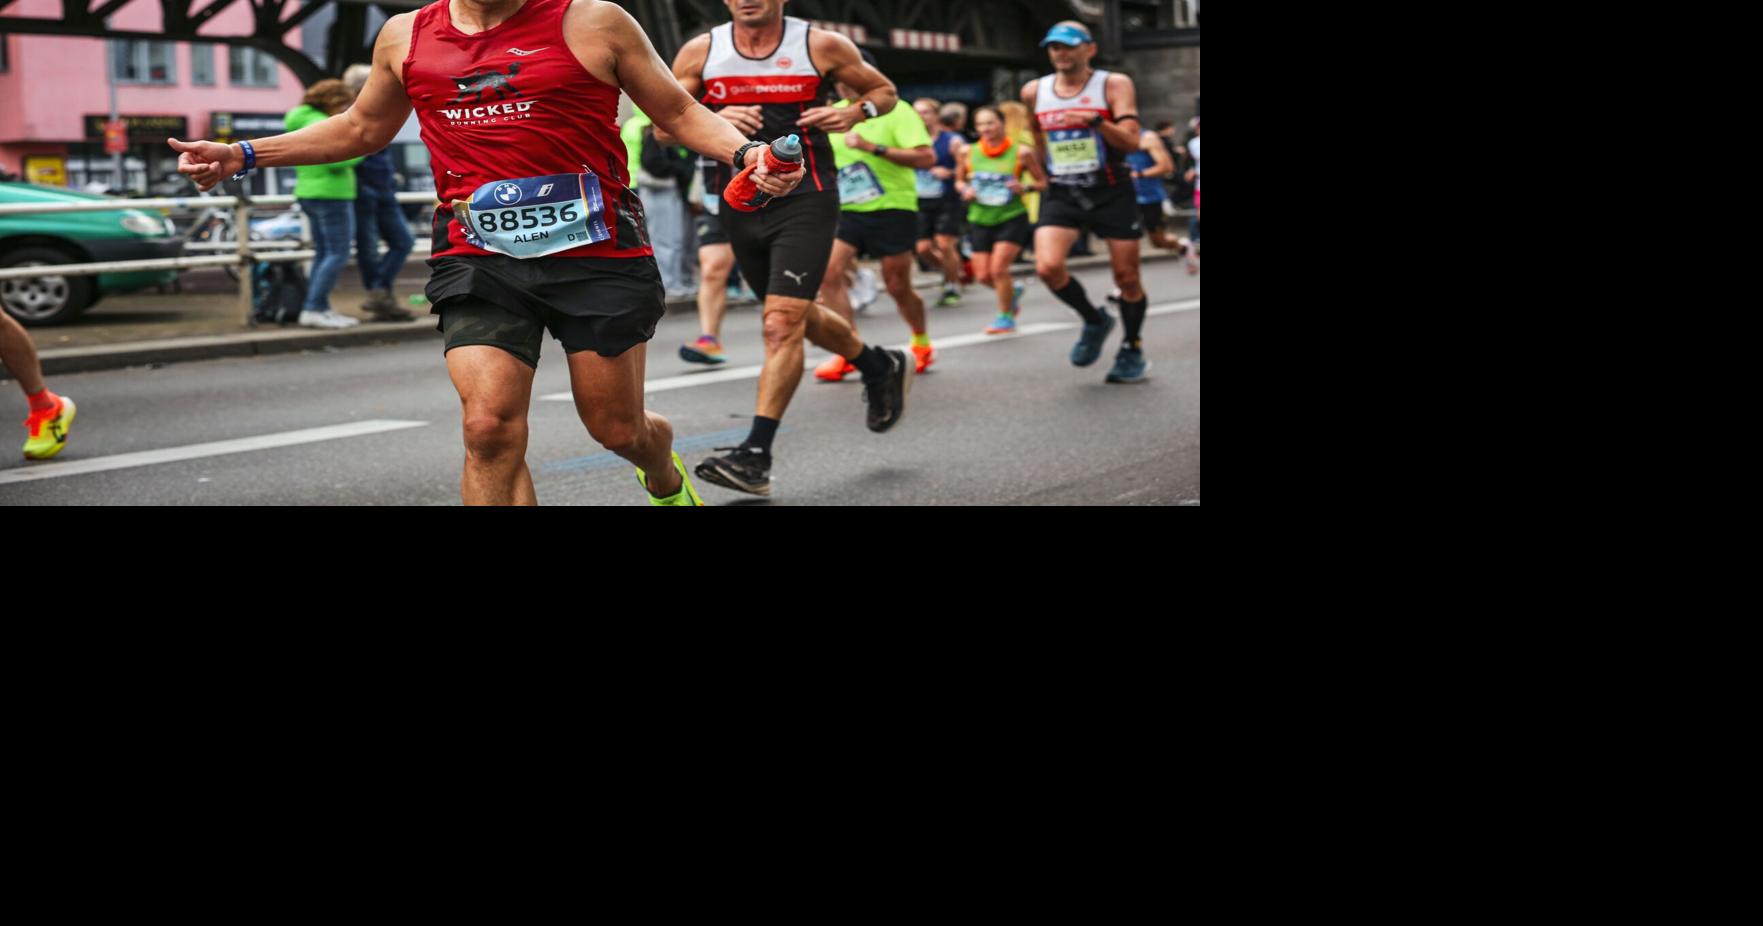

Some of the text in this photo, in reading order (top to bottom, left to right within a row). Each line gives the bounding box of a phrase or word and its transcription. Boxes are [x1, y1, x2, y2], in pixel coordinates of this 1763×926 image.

[437, 100, 538, 119] WICKED
[450, 113, 531, 126] RUNNING CLUB
[478, 203, 578, 232] 88536
[513, 231, 549, 244] ALEN
